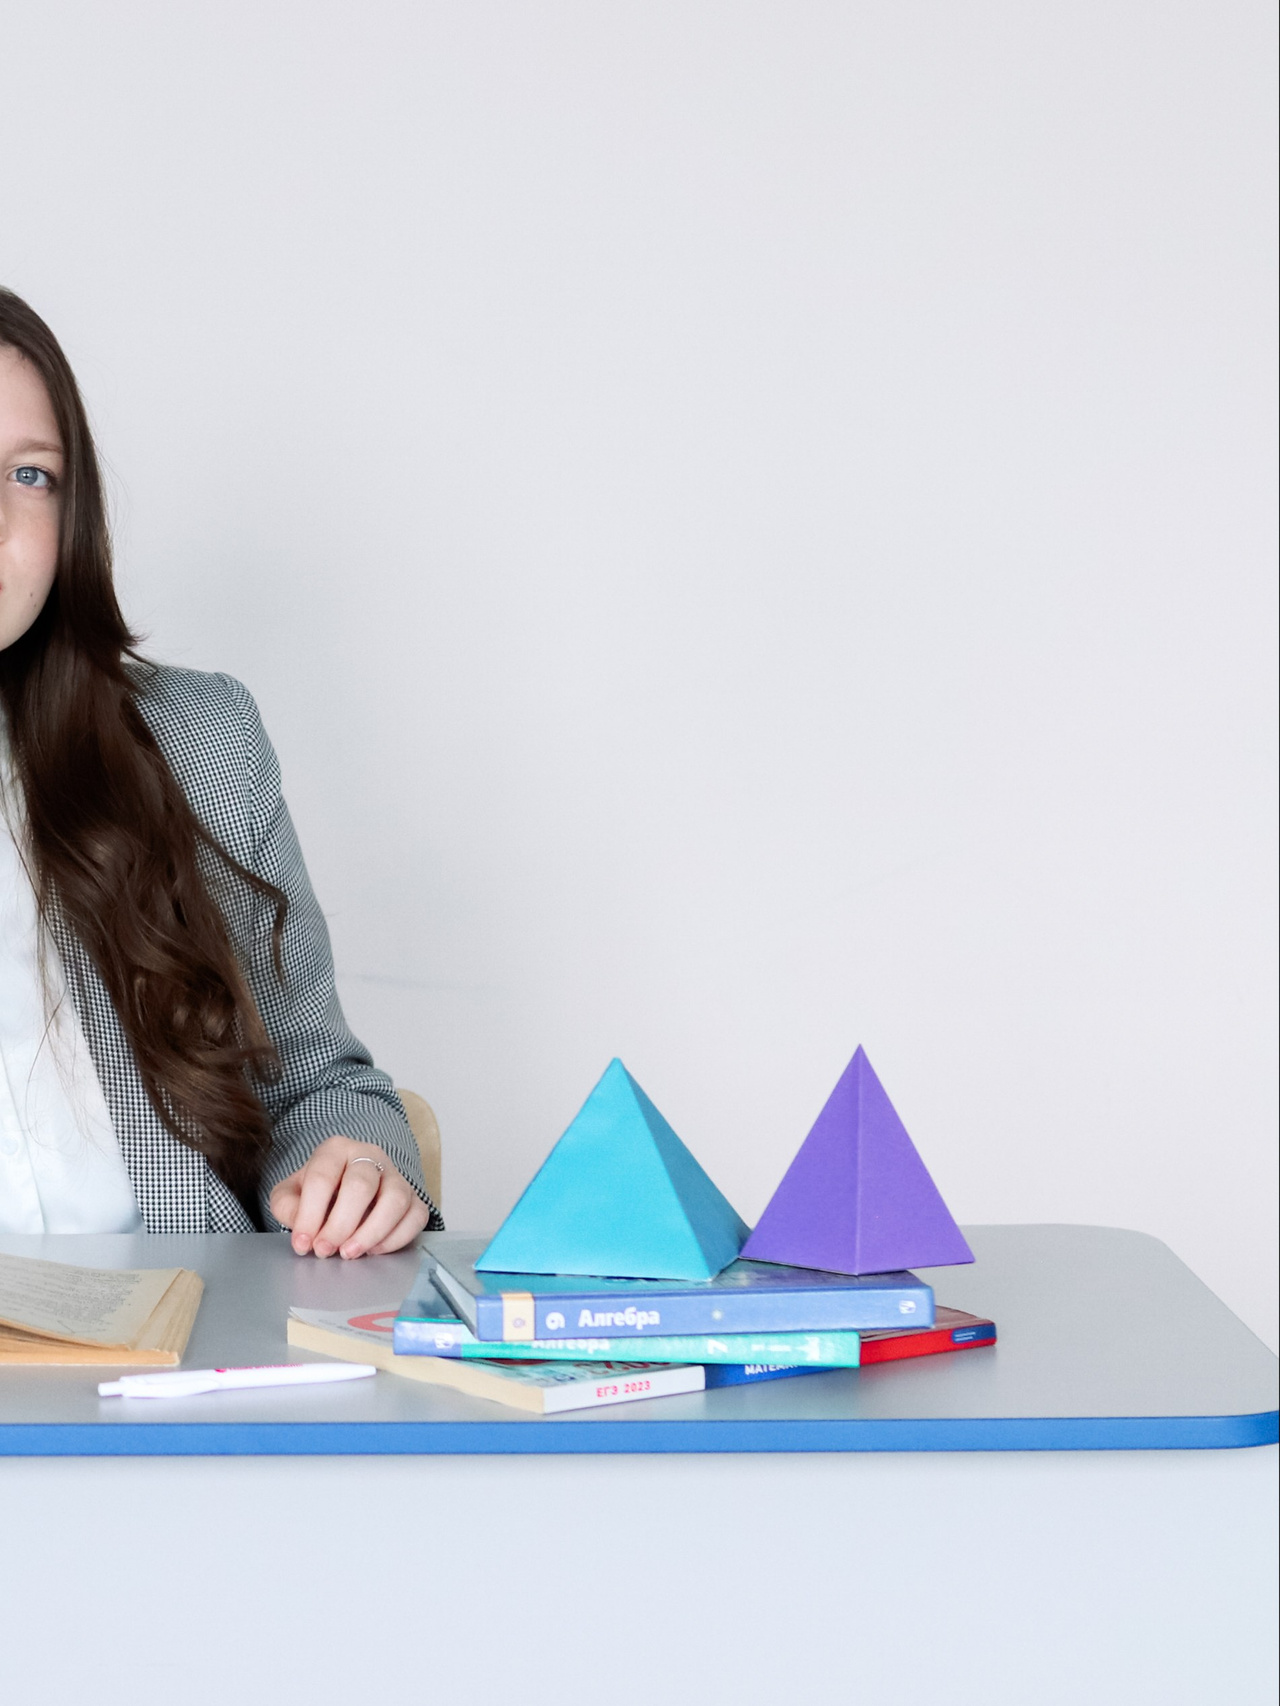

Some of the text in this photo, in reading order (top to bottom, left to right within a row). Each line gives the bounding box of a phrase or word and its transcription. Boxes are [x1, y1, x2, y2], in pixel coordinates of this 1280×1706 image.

[577, 1306, 661, 1330] Алгебра
[744, 1364, 799, 1375] МАТЕ
[596, 1380, 651, 1398] ЕГЭ 2023
